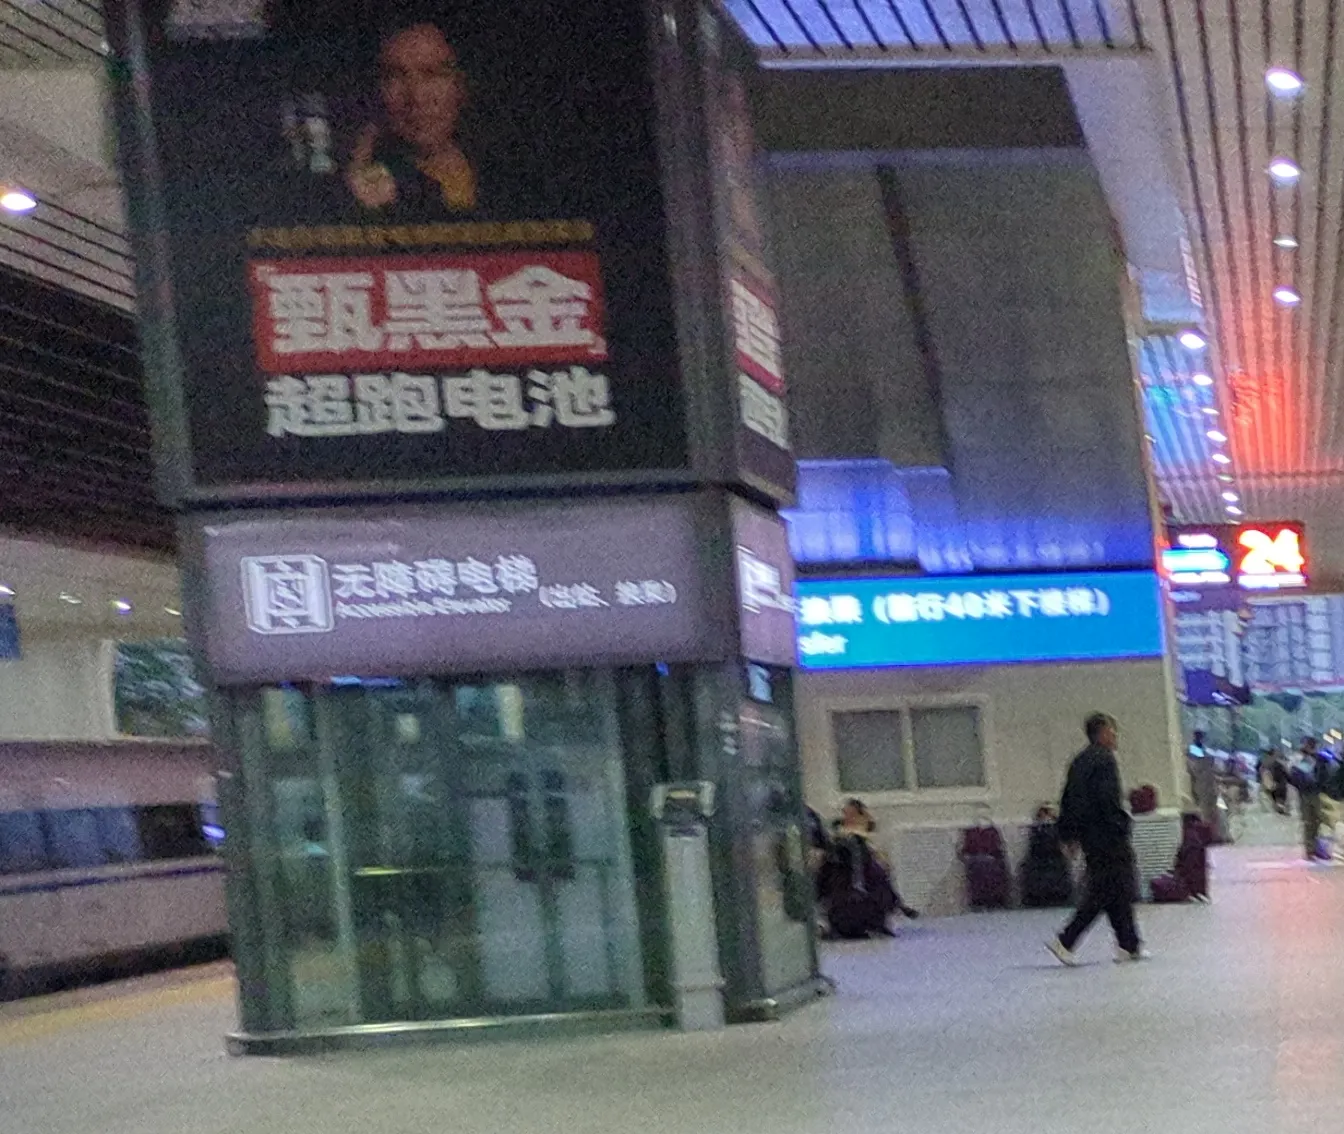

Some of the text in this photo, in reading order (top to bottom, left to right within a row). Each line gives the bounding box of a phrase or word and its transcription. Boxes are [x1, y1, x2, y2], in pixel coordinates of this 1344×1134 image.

[263, 265, 600, 352] 甄黑金
[264, 366, 616, 437] 超跑电池
[1239, 528, 1305, 574] 24
